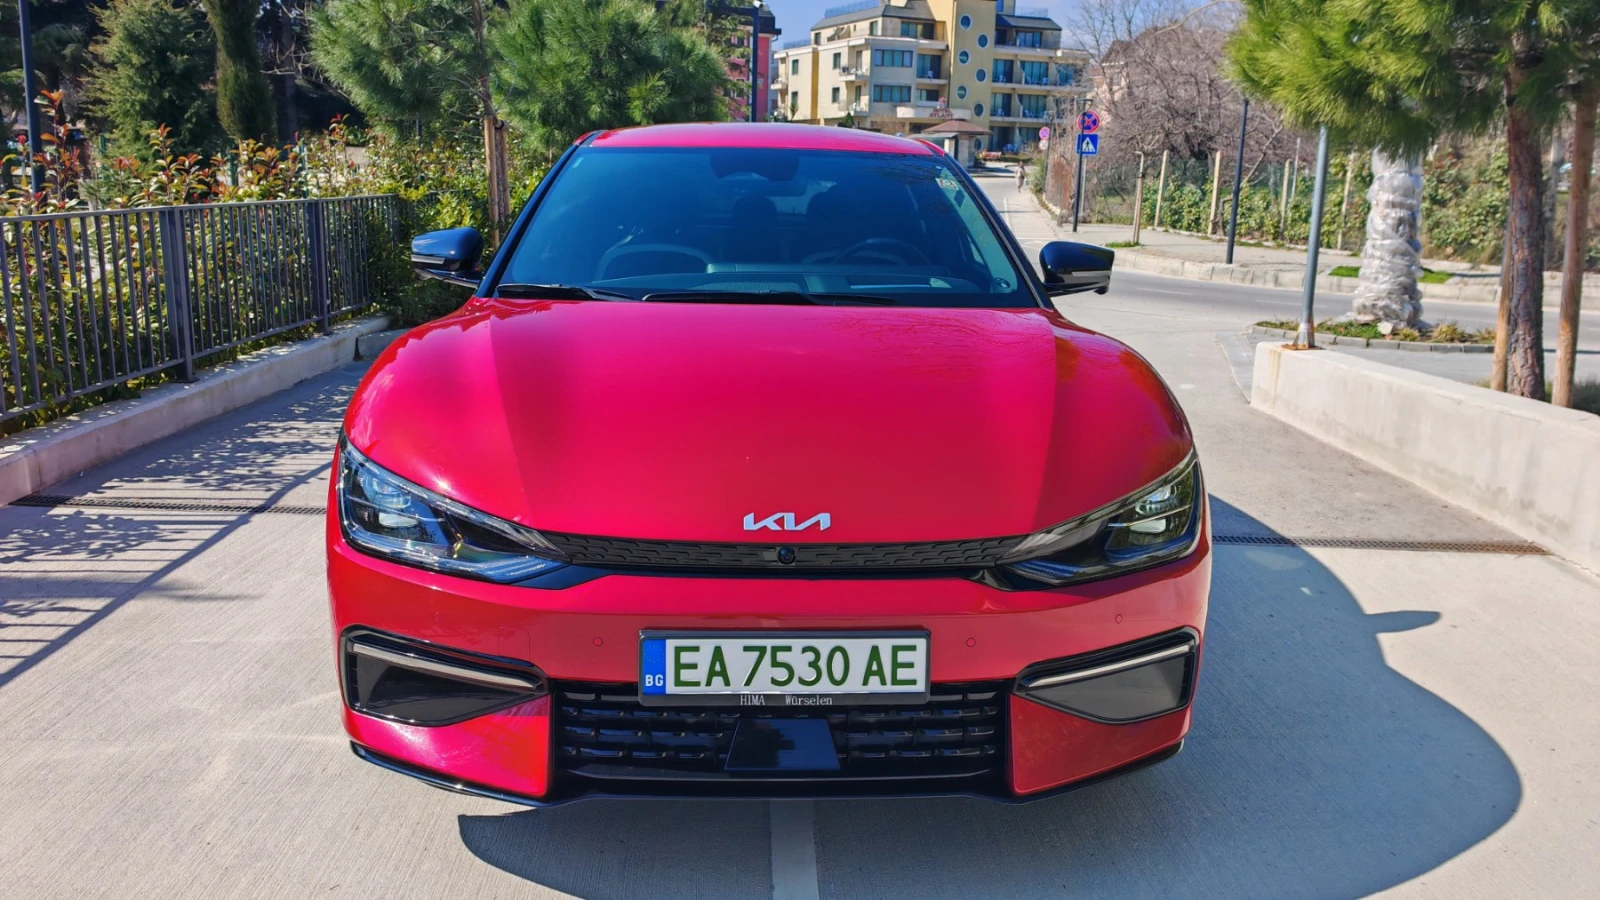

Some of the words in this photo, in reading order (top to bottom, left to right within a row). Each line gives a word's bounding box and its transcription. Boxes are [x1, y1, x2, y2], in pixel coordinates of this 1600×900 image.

[743, 512, 831, 531] KIA
[674, 646, 731, 687] EA
[743, 645, 850, 687] 7530
[861, 645, 917, 686] AE
[645, 674, 664, 687] BG
[740, 694, 766, 706] HIMA
[784, 694, 833, 706] Würselen
